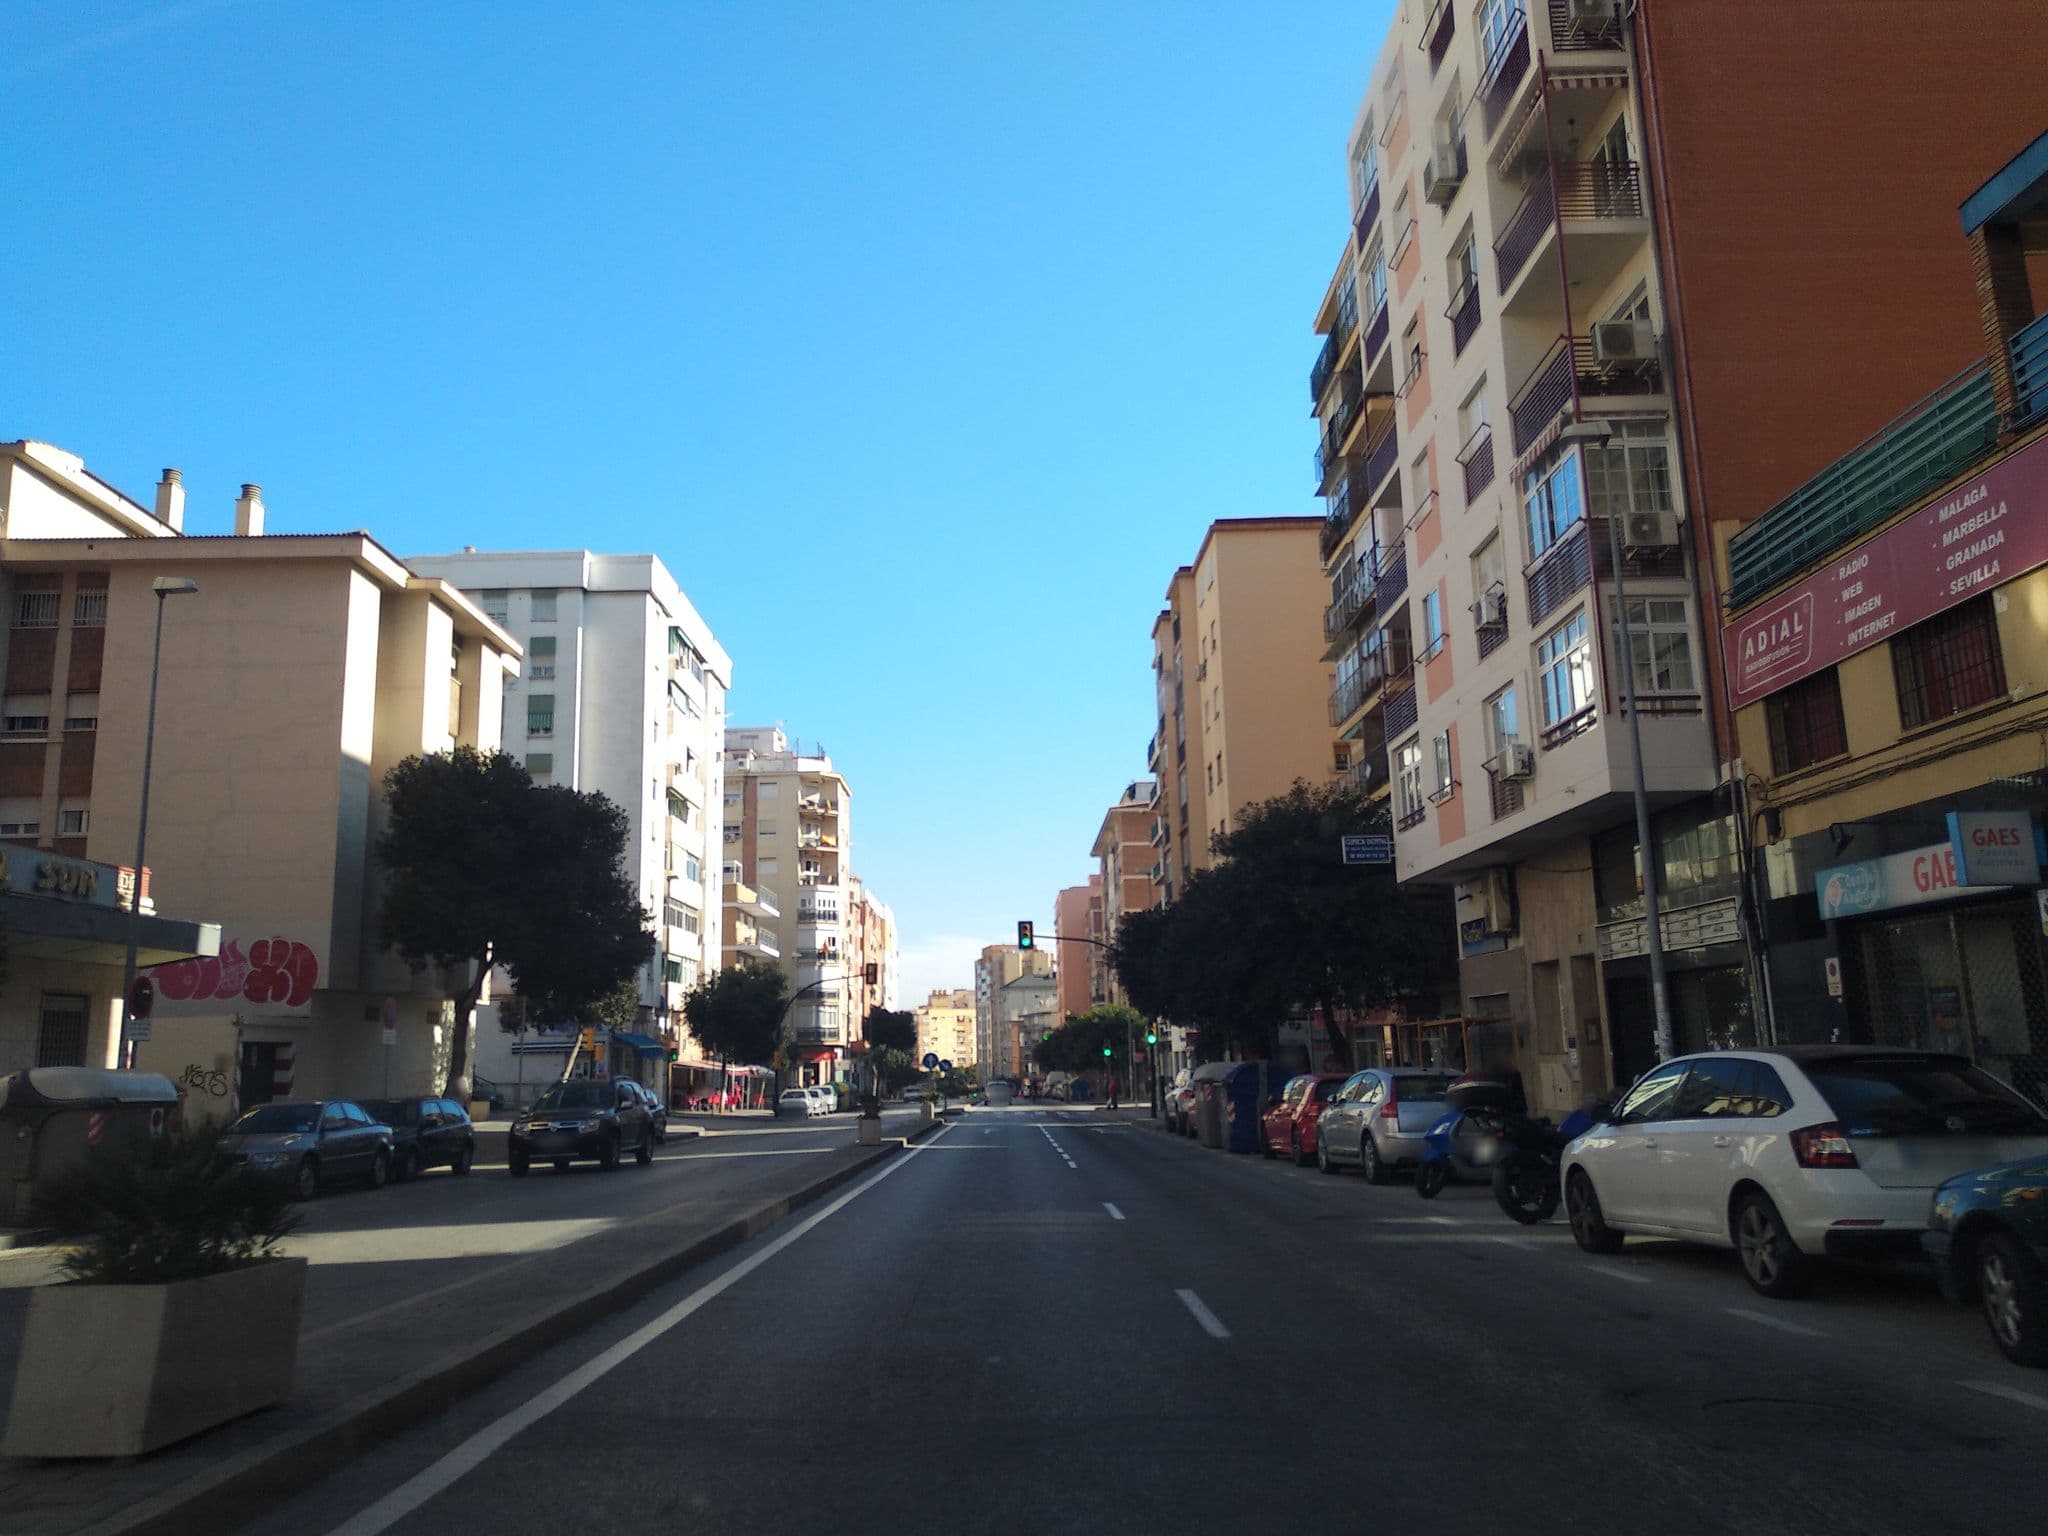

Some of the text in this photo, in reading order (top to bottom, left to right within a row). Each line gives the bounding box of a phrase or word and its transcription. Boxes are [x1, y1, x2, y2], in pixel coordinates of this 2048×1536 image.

[1938, 484, 1988, 523] MALAGA
[1942, 501, 2008, 548] MARBELLA
[1839, 554, 1869, 581] RADIO
[1946, 530, 2005, 571] GRANADA
[1842, 581, 1864, 602] WEB
[1949, 559, 2001, 595] SEVILLA
[1845, 594, 1882, 625] IMAGEN
[1744, 611, 1803, 660] ADIAL
[1848, 611, 1897, 646] INTERNET
[1971, 827, 2021, 847] GAES
[1912, 850, 1957, 893] GAE
